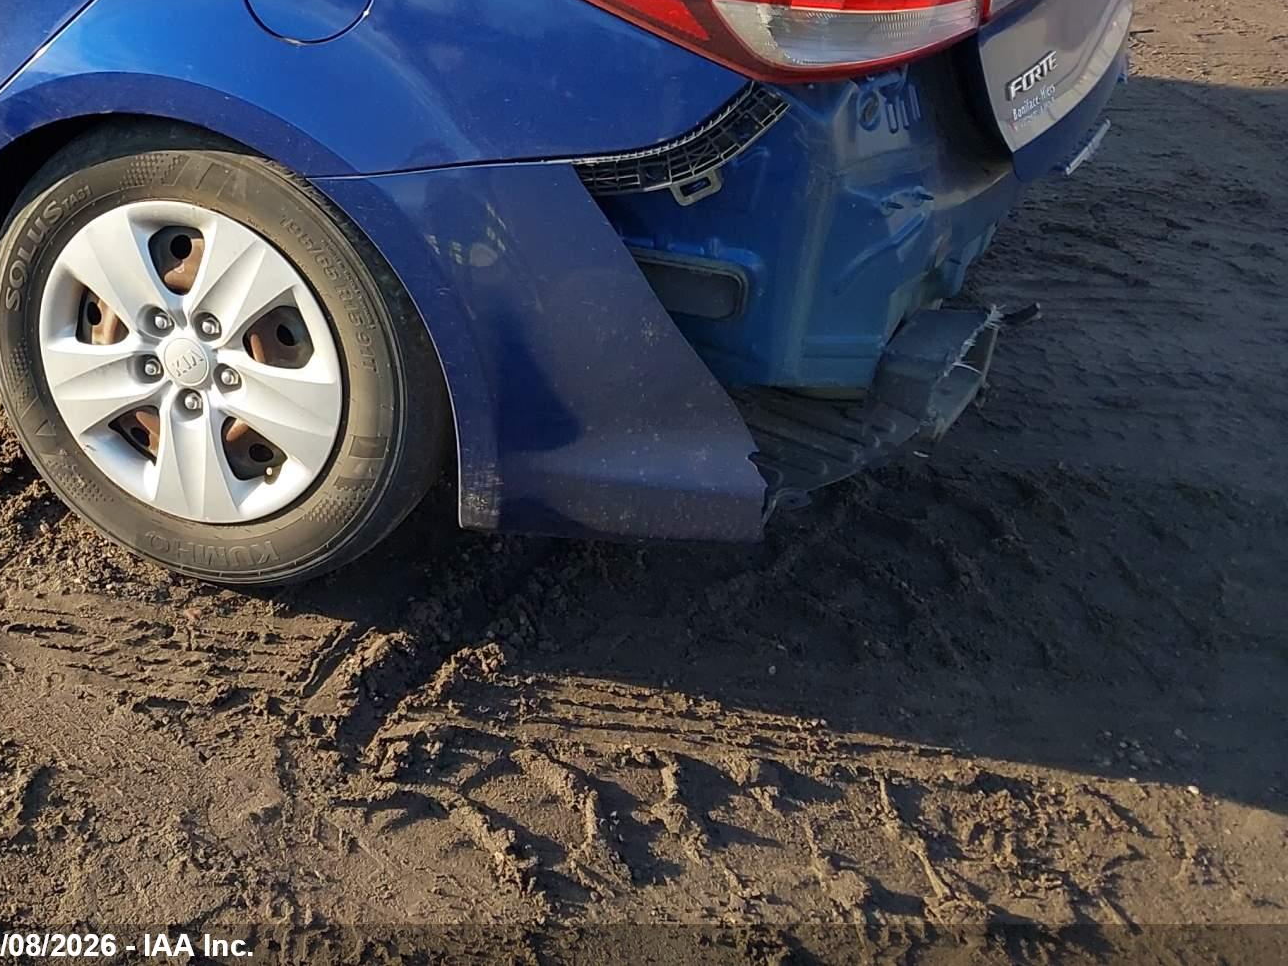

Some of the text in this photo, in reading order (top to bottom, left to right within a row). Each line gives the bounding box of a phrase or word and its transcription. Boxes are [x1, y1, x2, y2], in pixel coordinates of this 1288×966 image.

[1010, 50, 1058, 100] FORTE
[5, 200, 64, 312] SOLUS
[144, 531, 280, 567] KUMHO
